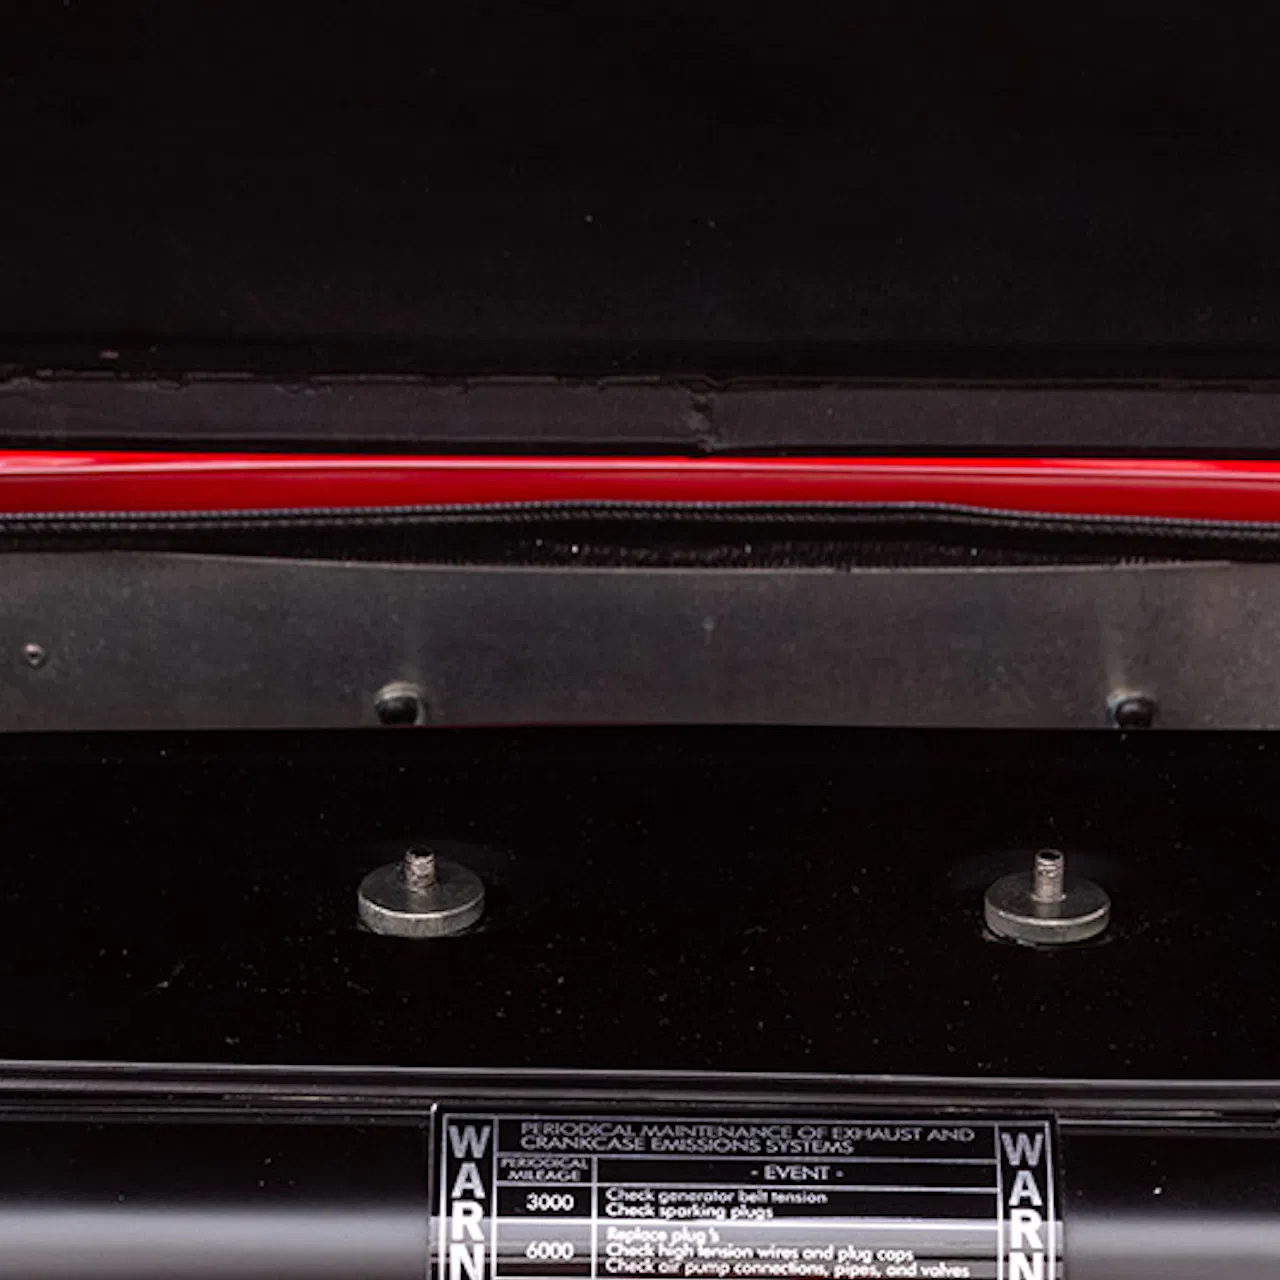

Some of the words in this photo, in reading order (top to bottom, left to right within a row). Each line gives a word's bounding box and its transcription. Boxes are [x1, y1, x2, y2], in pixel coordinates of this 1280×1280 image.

[521, 1122, 636, 1137] PERIODICAL
[639, 1123, 792, 1139] MAINTENANCE
[798, 1125, 829, 1139] OF
[832, 1126, 922, 1141] EXHAUST
[926, 1127, 975, 1142] AND
[521, 1135, 645, 1151] CRANKCASE
[651, 1137, 761, 1152] EMISSIONS
[766, 1139, 854, 1155] SYSTEMS
[507, 1169, 581, 1182] MILEAGE
[763, 1164, 831, 1181] EVENT
[526, 1193, 574, 1212] 3000
[605, 1187, 655, 1202] Check
[658, 1190, 735, 1204] generator
[738, 1190, 768, 1203] belt
[771, 1190, 828, 1204] tension
[605, 1202, 655, 1217] Check
[660, 1204, 726, 1220] sparking
[730, 1204, 773, 1220] plugs
[607, 1226, 667, 1244] Replace
[525, 1241, 574, 1261] 6000
[605, 1242, 655, 1257] Check
[658, 1243, 694, 1261] high
[697, 1243, 754, 1259] tension
[757, 1245, 802, 1261] wires
[805, 1246, 834, 1262] and
[838, 1246, 872, 1268] plug
[876, 1249, 914, 1267] caps
[605, 1258, 655, 1273] Check
[658, 1260, 681, 1274] air
[684, 1263, 730, 1278] pump
[733, 1261, 828, 1278] connections,
[833, 1261, 882, 1279] pipes,
[886, 1262, 918, 1278] and
[920, 1262, 970, 1279] valves
